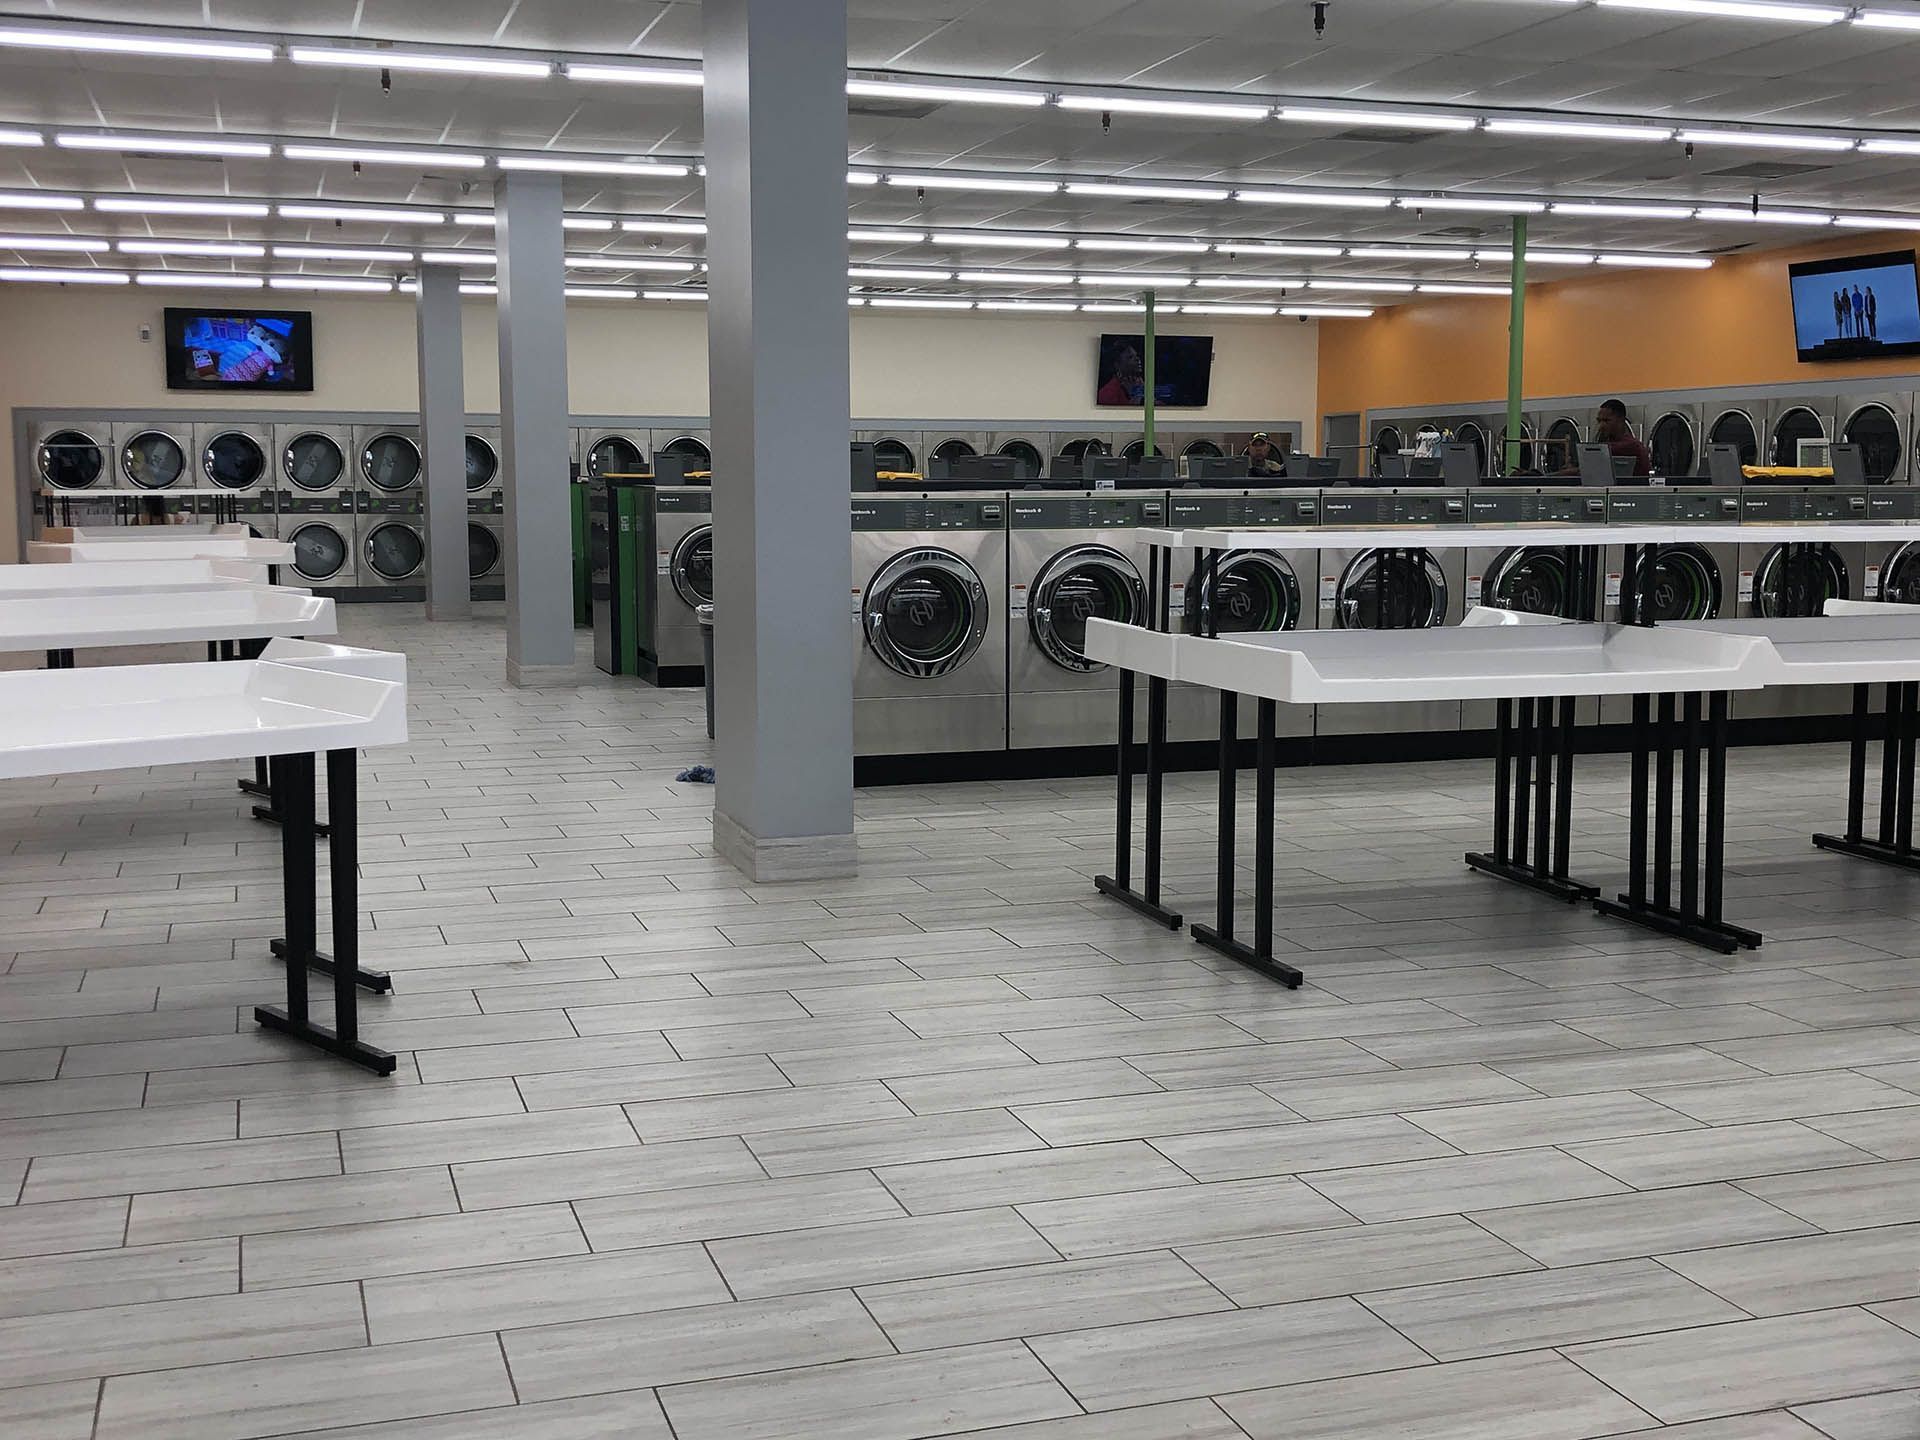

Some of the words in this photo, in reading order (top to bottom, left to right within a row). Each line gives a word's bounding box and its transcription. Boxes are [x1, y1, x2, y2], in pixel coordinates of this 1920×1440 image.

[1230, 592, 1251, 617] H
[1522, 586, 1541, 610] H
[1655, 584, 1674, 608] H
[910, 600, 934, 626] H
